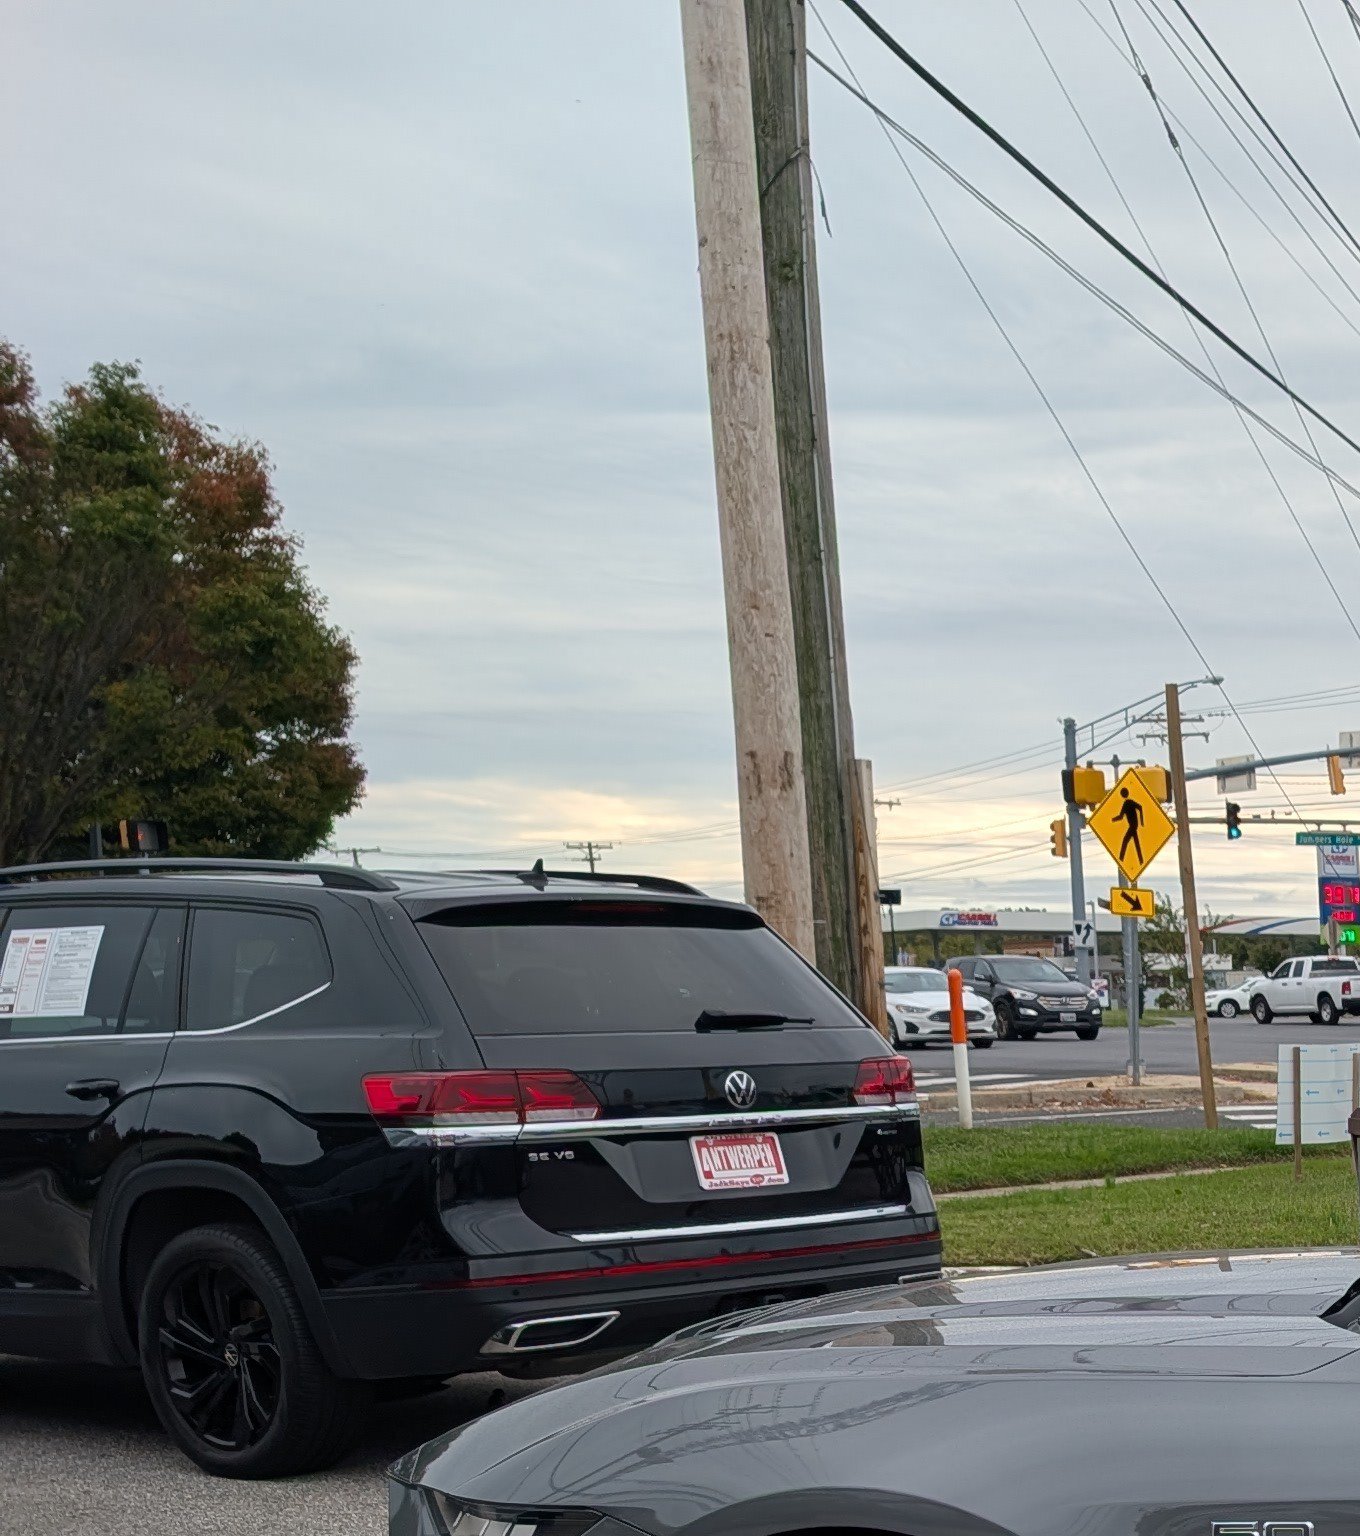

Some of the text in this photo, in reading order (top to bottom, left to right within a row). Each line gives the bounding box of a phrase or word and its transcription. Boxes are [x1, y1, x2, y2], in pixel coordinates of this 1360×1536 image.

[528, 1150, 575, 1162] SE V6
[701, 1143, 775, 1173] ANTWERPEN
